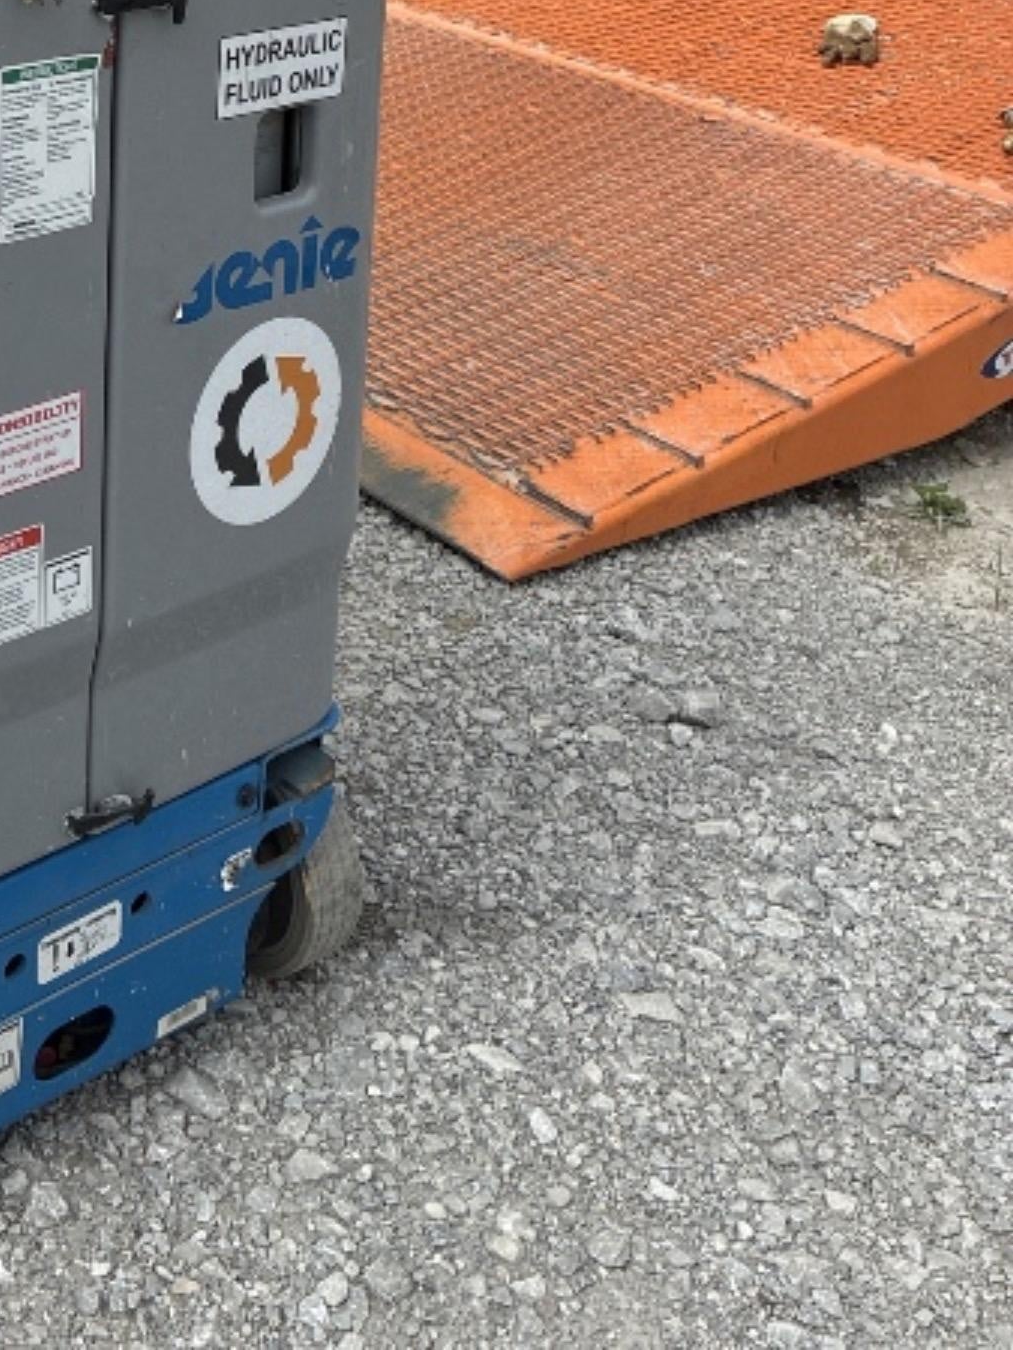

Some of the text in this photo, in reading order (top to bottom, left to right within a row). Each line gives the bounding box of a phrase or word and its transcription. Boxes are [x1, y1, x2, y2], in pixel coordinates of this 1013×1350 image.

[226, 29, 342, 71] HYDRAULIC
[224, 63, 340, 106] FLUID ONLY
